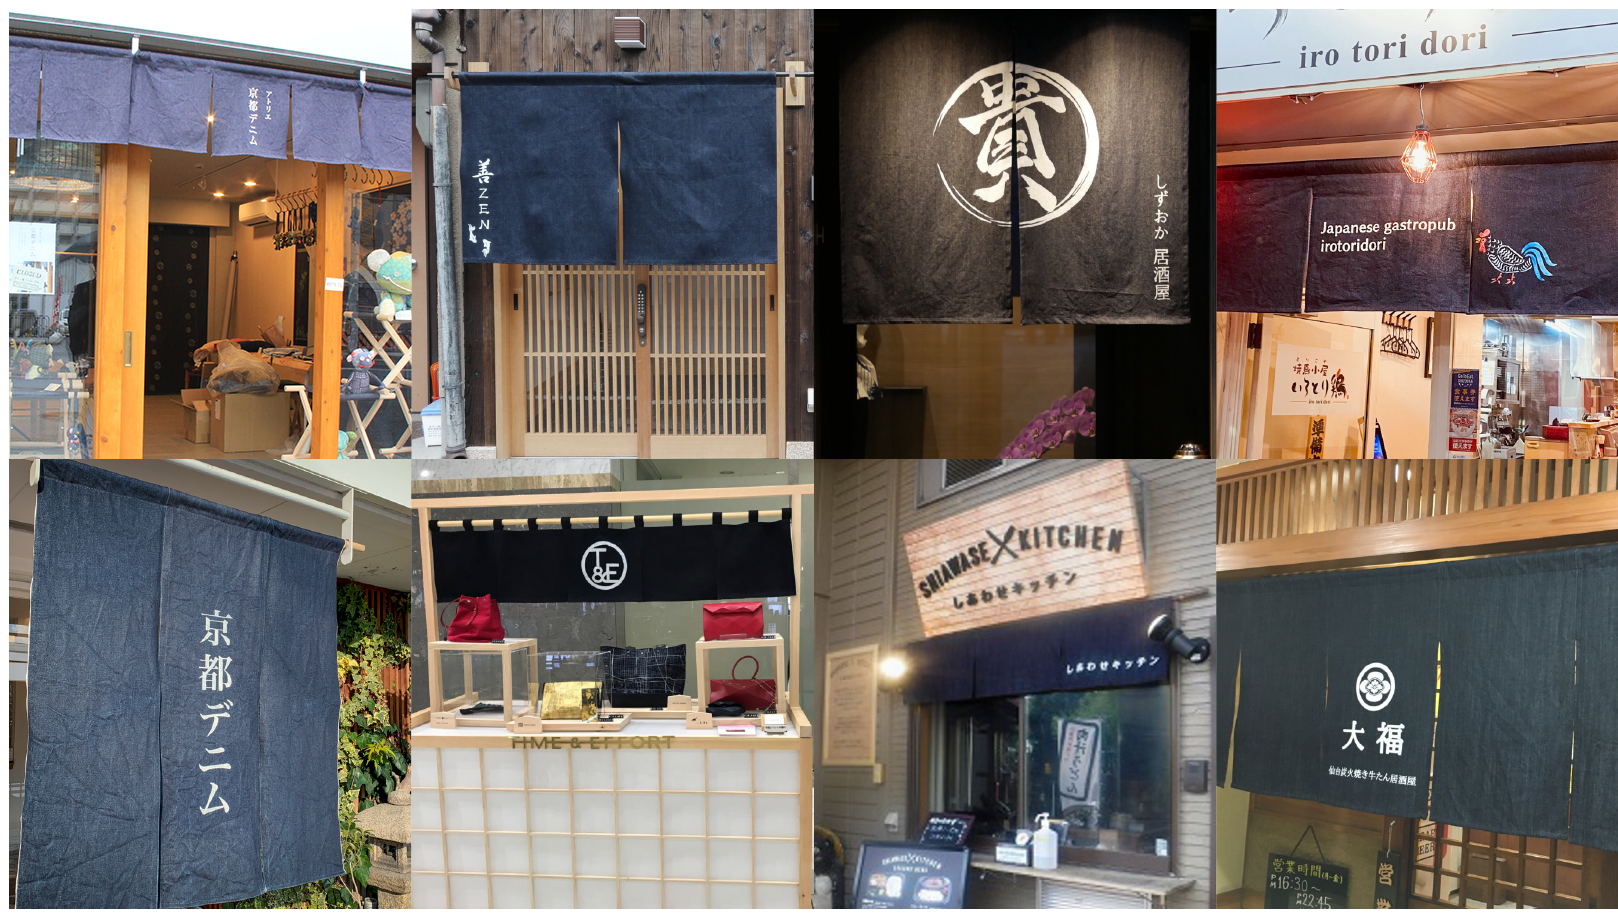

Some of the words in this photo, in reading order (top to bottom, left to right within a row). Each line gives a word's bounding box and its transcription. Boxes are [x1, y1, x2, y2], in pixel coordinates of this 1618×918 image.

[1299, 46, 1339, 69] iro
[1352, 33, 1407, 63] tori
[1420, 24, 1488, 56] dori
[248, 87, 259, 146] 京都デニム
[265, 90, 273, 120] アトリエ
[958, 71, 1066, 212] 貴
[472, 158, 494, 184] 善
[478, 187, 490, 230] ZEN
[1154, 174, 1168, 240] しずおか
[1320, 221, 1380, 236] Japanese
[1383, 217, 1456, 235] gastropub
[1320, 236, 1386, 252] irotoridori
[16, 268, 42, 279] CLOSED
[1153, 248, 1170, 301] 居酒屋
[919, 541, 991, 599] SHIAWASE
[1018, 525, 1123, 553] KITCHEN
[953, 571, 1076, 609] しあわせキッチン
[1066, 655, 1160, 675] しあわせキッチン
[198, 609, 234, 816] 京都デニム
[1341, 720, 1406, 756] 大福
